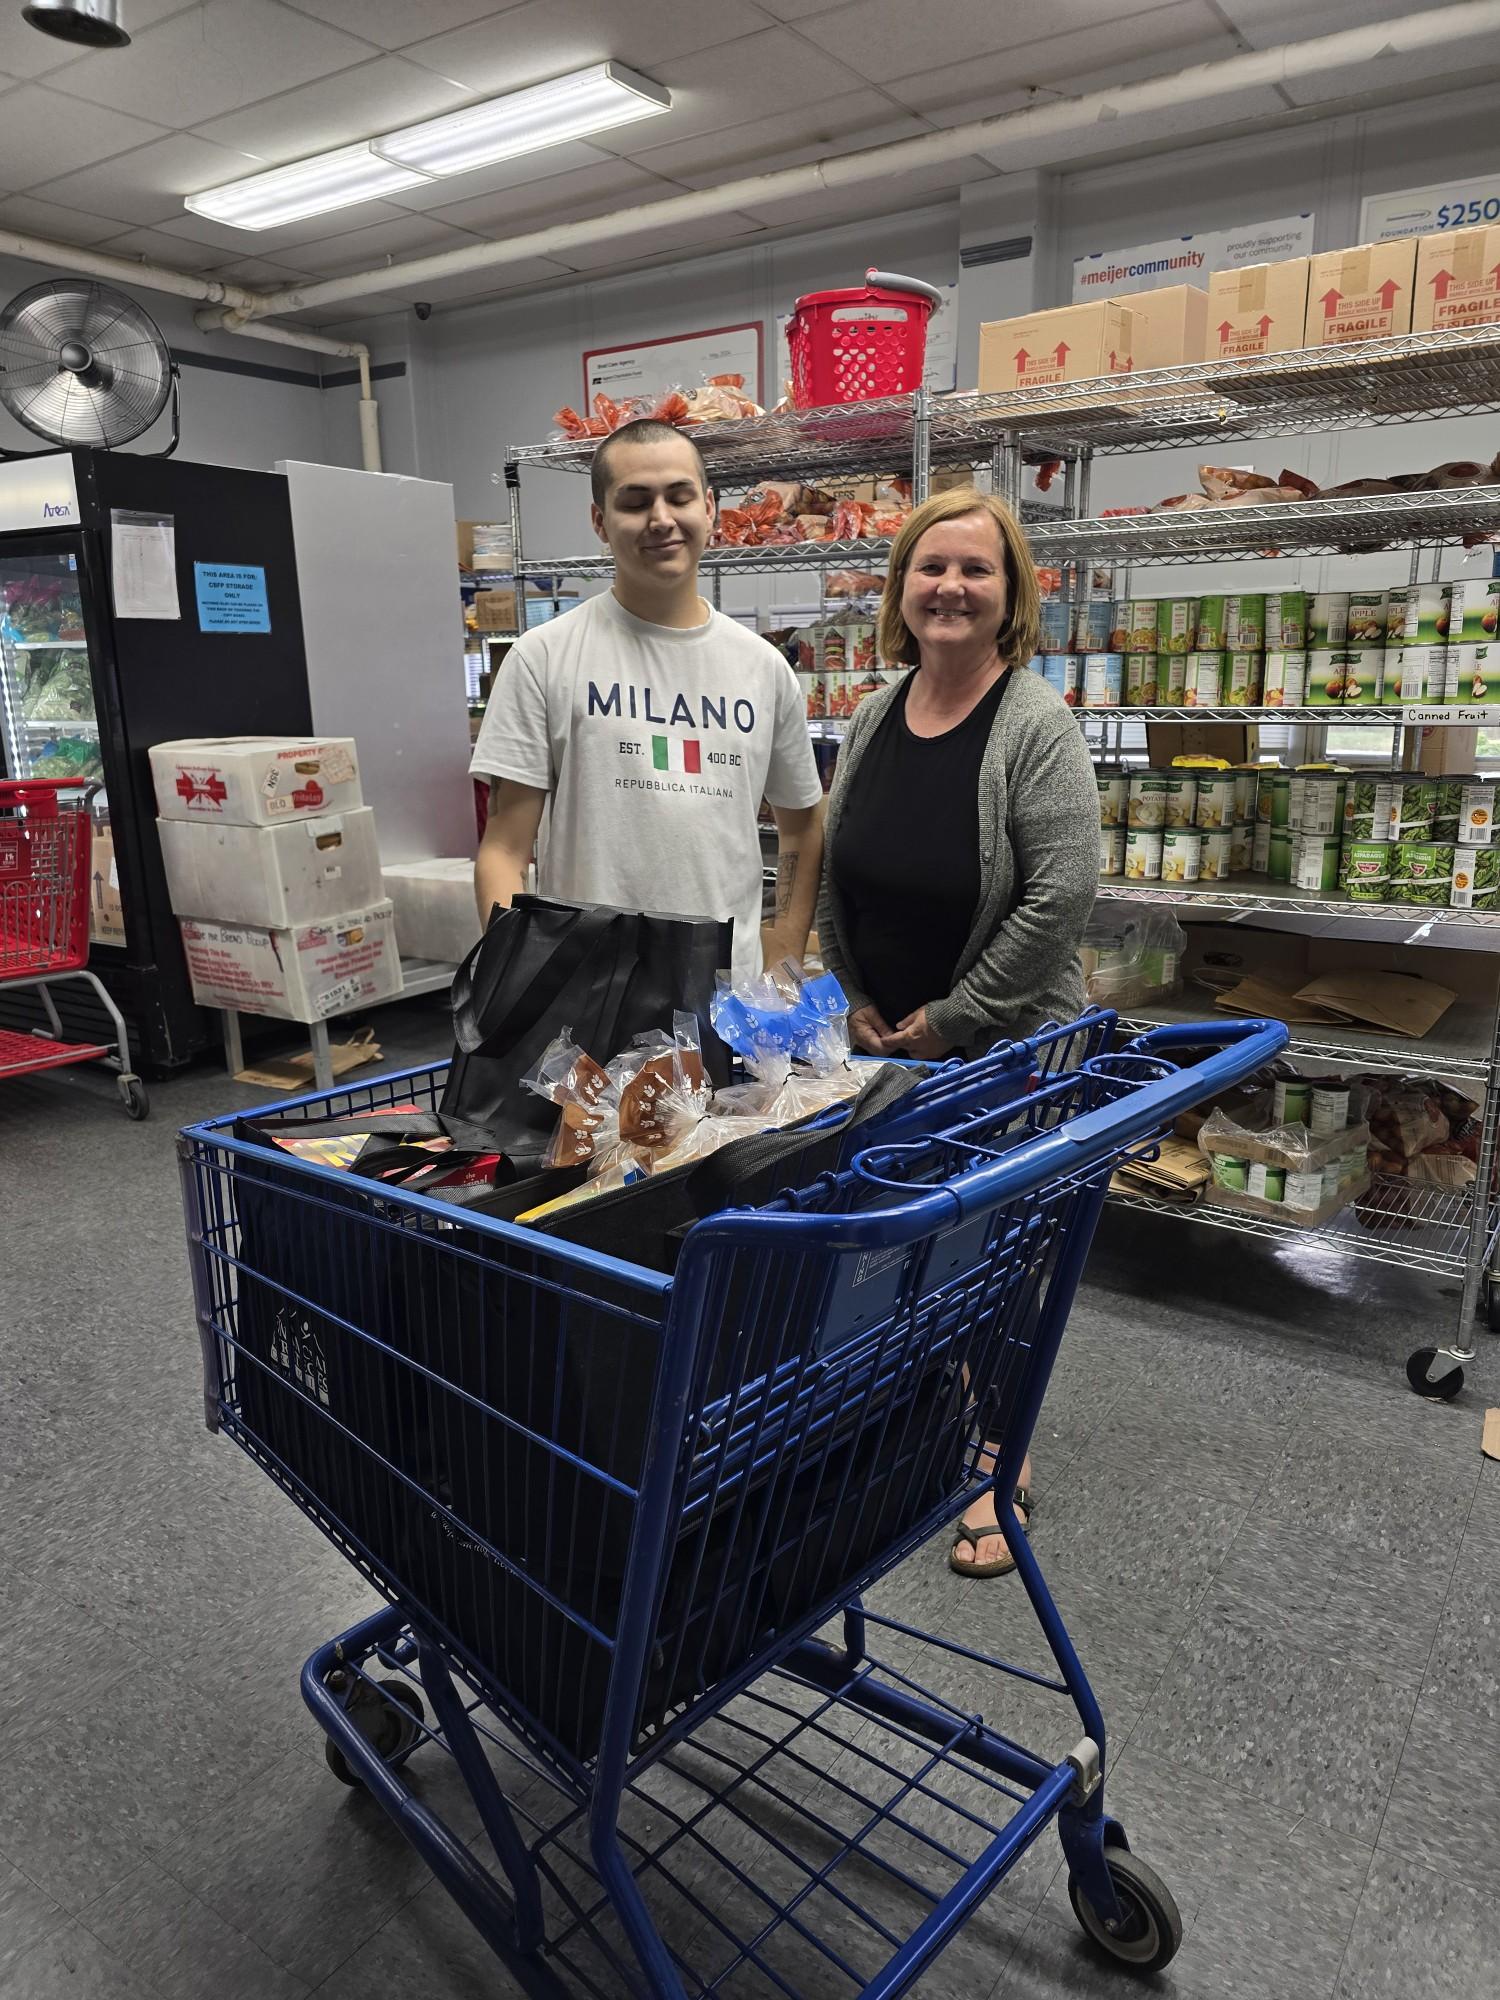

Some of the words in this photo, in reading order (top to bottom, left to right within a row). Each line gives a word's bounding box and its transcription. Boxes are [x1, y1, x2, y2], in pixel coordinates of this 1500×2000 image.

[1380, 224, 1434, 238] FOUNDATION
[1227, 238, 1257, 253] proudly
[1258, 231, 1302, 247] supporting
[1233, 250, 1247, 259] our
[1249, 243, 1293, 257] community
[1080, 250, 1205, 285] #meijercommunity
[1439, 298, 1500, 316] FRAGILE
[1328, 317, 1387, 334] FRAGILE
[1223, 342, 1264, 355] FRAGILE
[1019, 373, 1062, 387] FRAGILE
[1351, 609, 1376, 617] APPLE
[588, 681, 755, 733] MILANO
[1409, 709, 1450, 720] Canned
[1458, 710, 1488, 720] Fruit
[277, 749, 316, 759] PROPERTY
[619, 741, 645, 755] EST.
[707, 752, 726, 765] 400
[729, 753, 741, 766] BC
[615, 778, 685, 793] REPUBBLICA
[690, 785, 733, 799] ITALIANA
[1354, 851, 1385, 859] ASPARAGUS
[221, 928, 242, 944] BREAD
